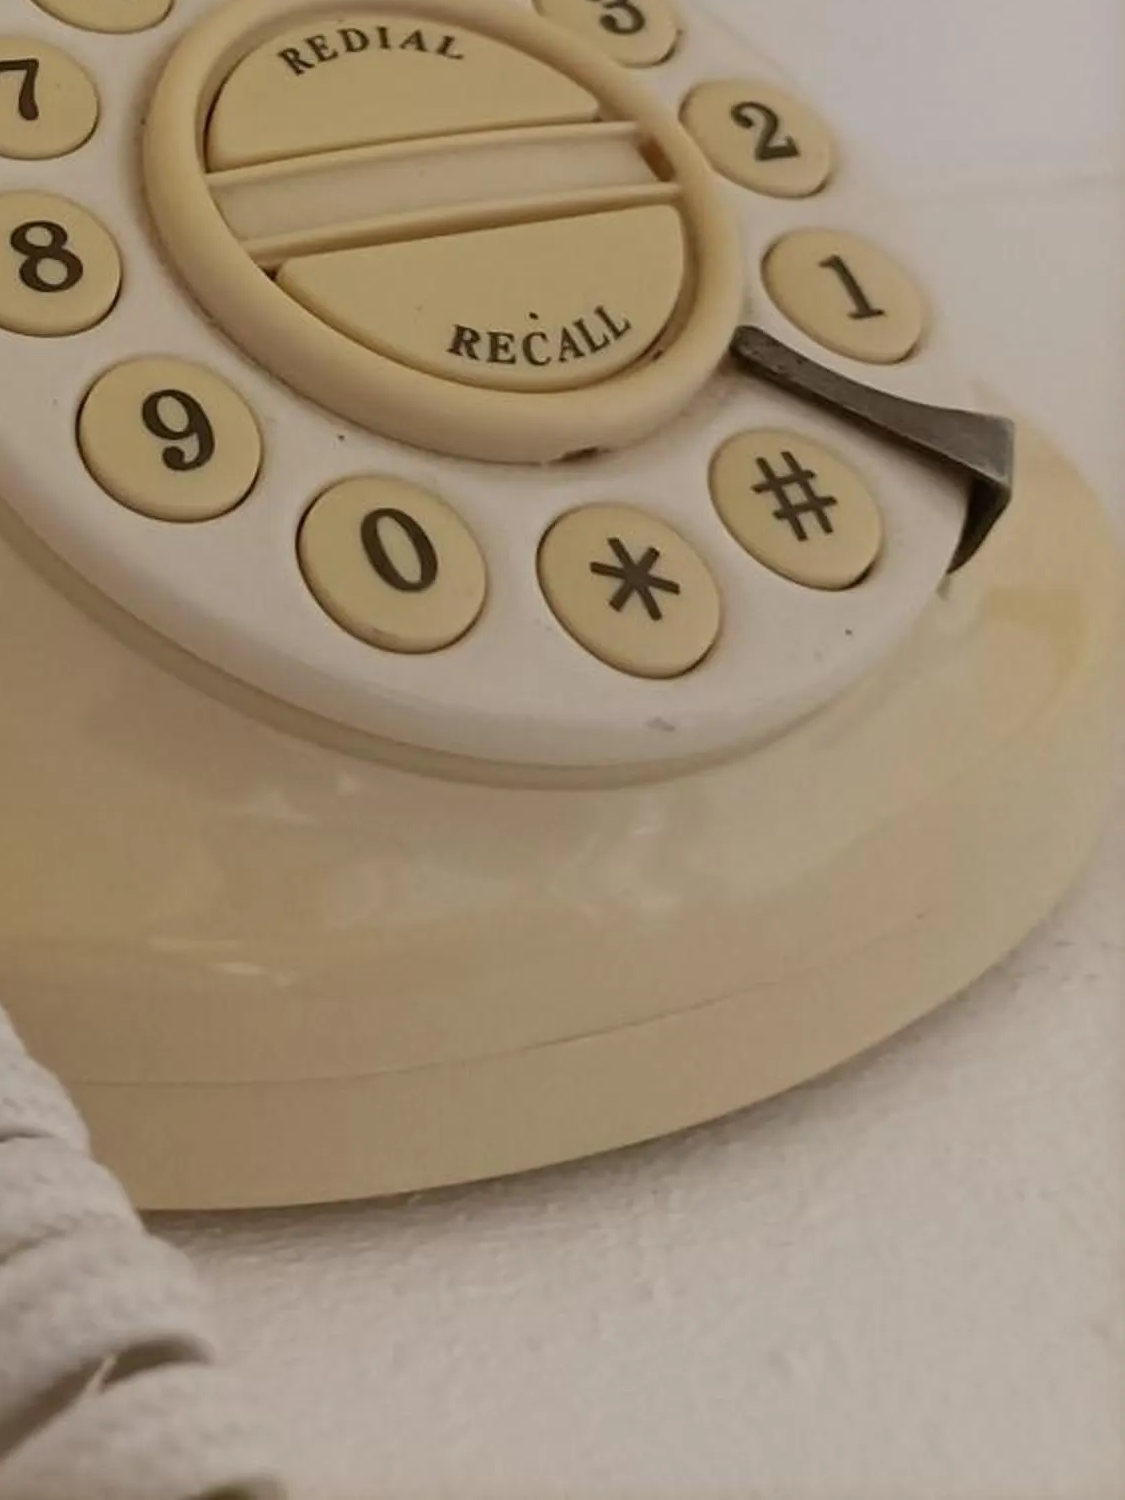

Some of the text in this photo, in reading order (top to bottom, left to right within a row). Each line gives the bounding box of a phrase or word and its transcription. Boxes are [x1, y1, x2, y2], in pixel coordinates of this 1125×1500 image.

[277, 26, 464, 76] REDIAL
[730, 101, 800, 162] 2
[9, 220, 84, 293] 8
[819, 255, 886, 321] 1
[446, 306, 632, 367] RECALL
[141, 388, 216, 472] 9
[360, 507, 439, 593] 0
